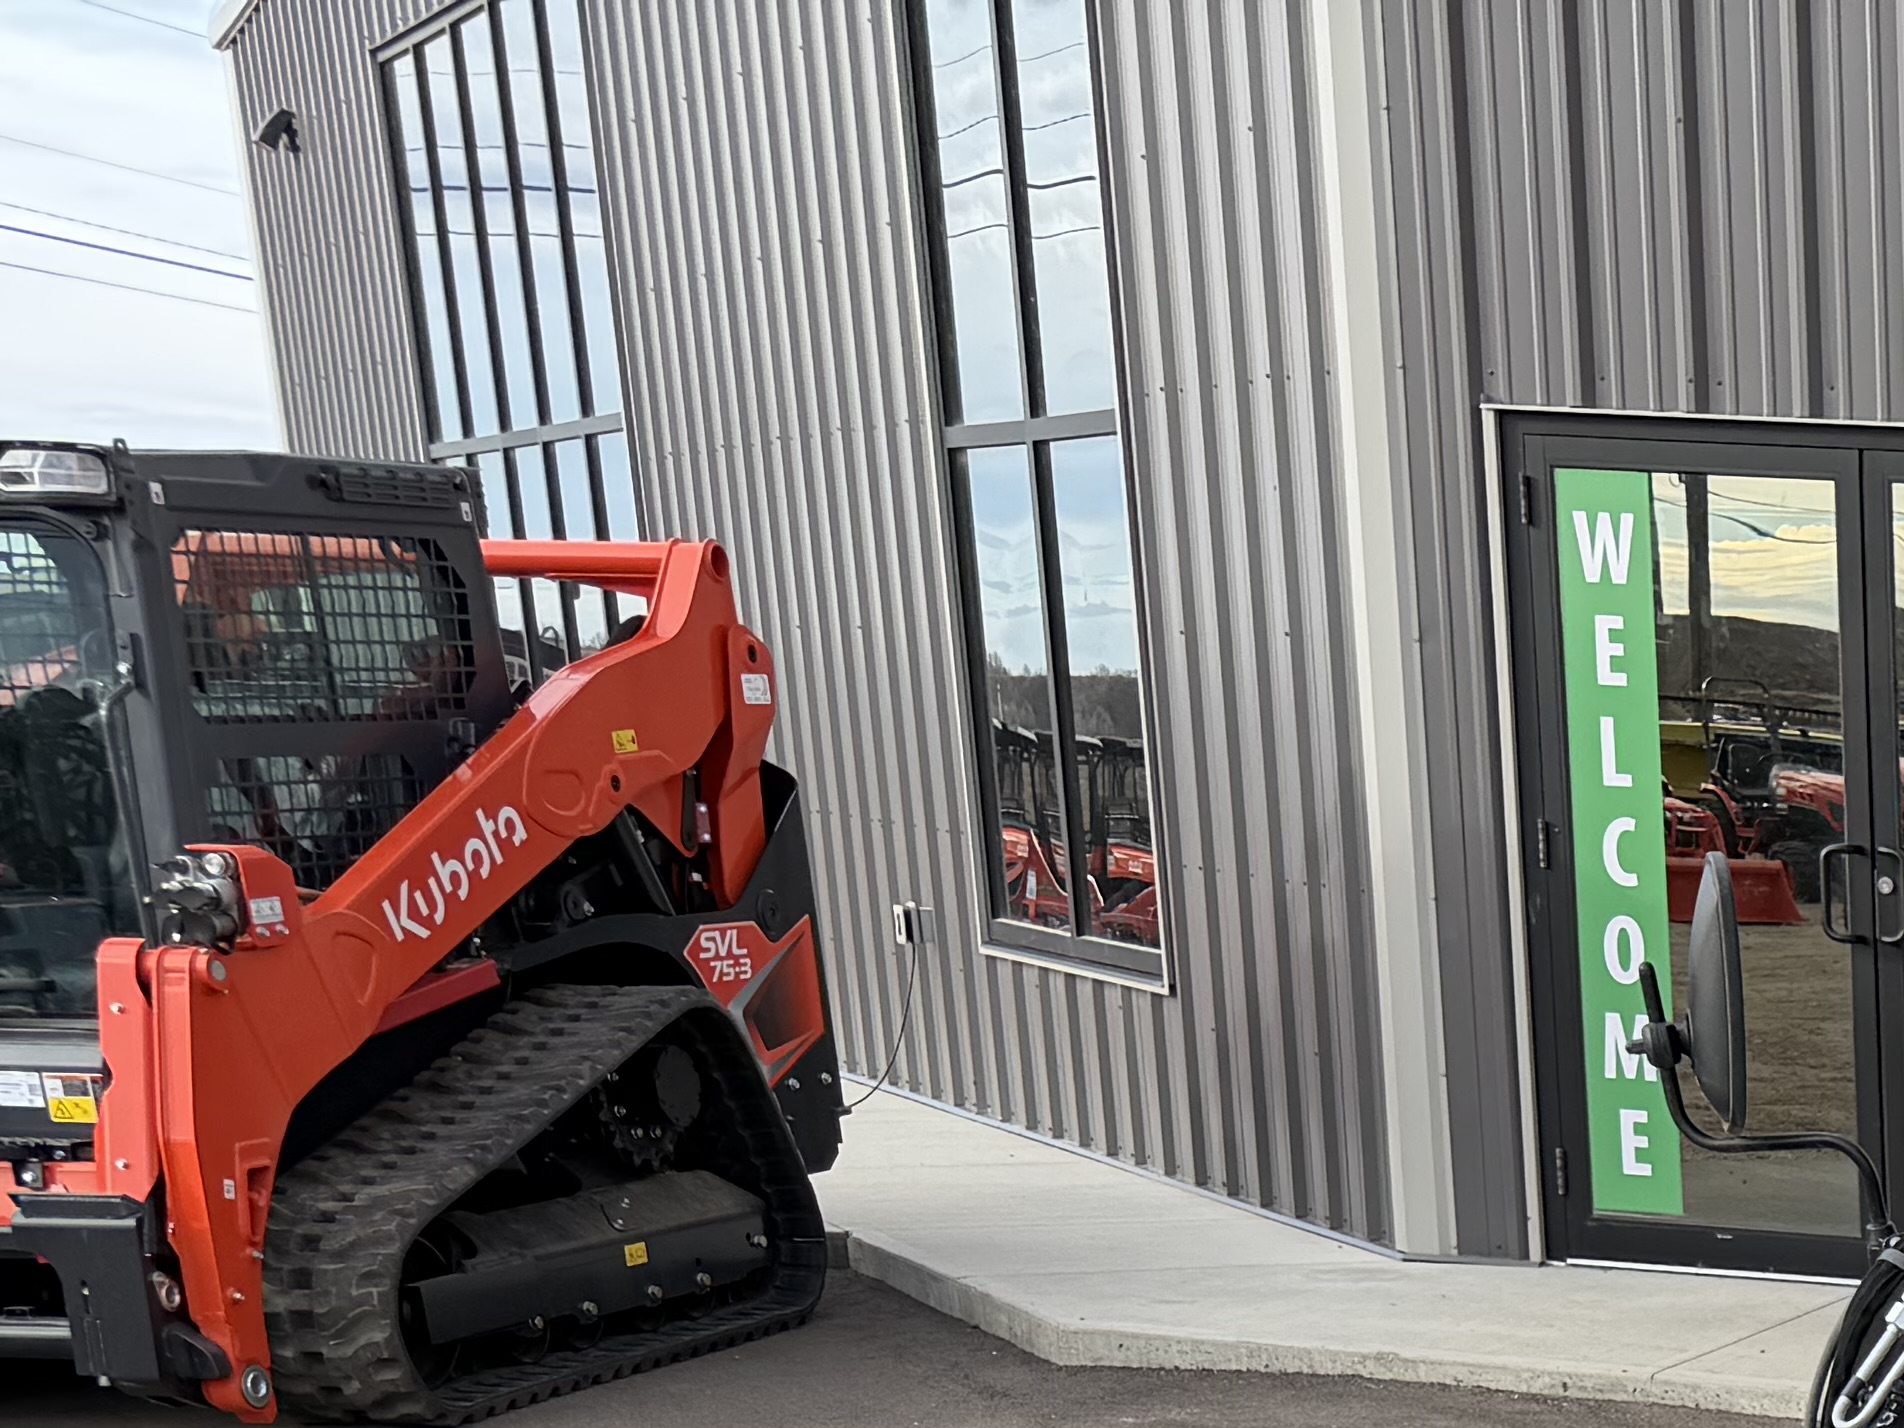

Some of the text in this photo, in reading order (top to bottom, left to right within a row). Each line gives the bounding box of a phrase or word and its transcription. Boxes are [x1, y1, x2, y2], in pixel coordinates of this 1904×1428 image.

[381, 806, 529, 942] Kubota
[1572, 510, 1658, 1177] WELCOME
[700, 930, 748, 959] SVL
